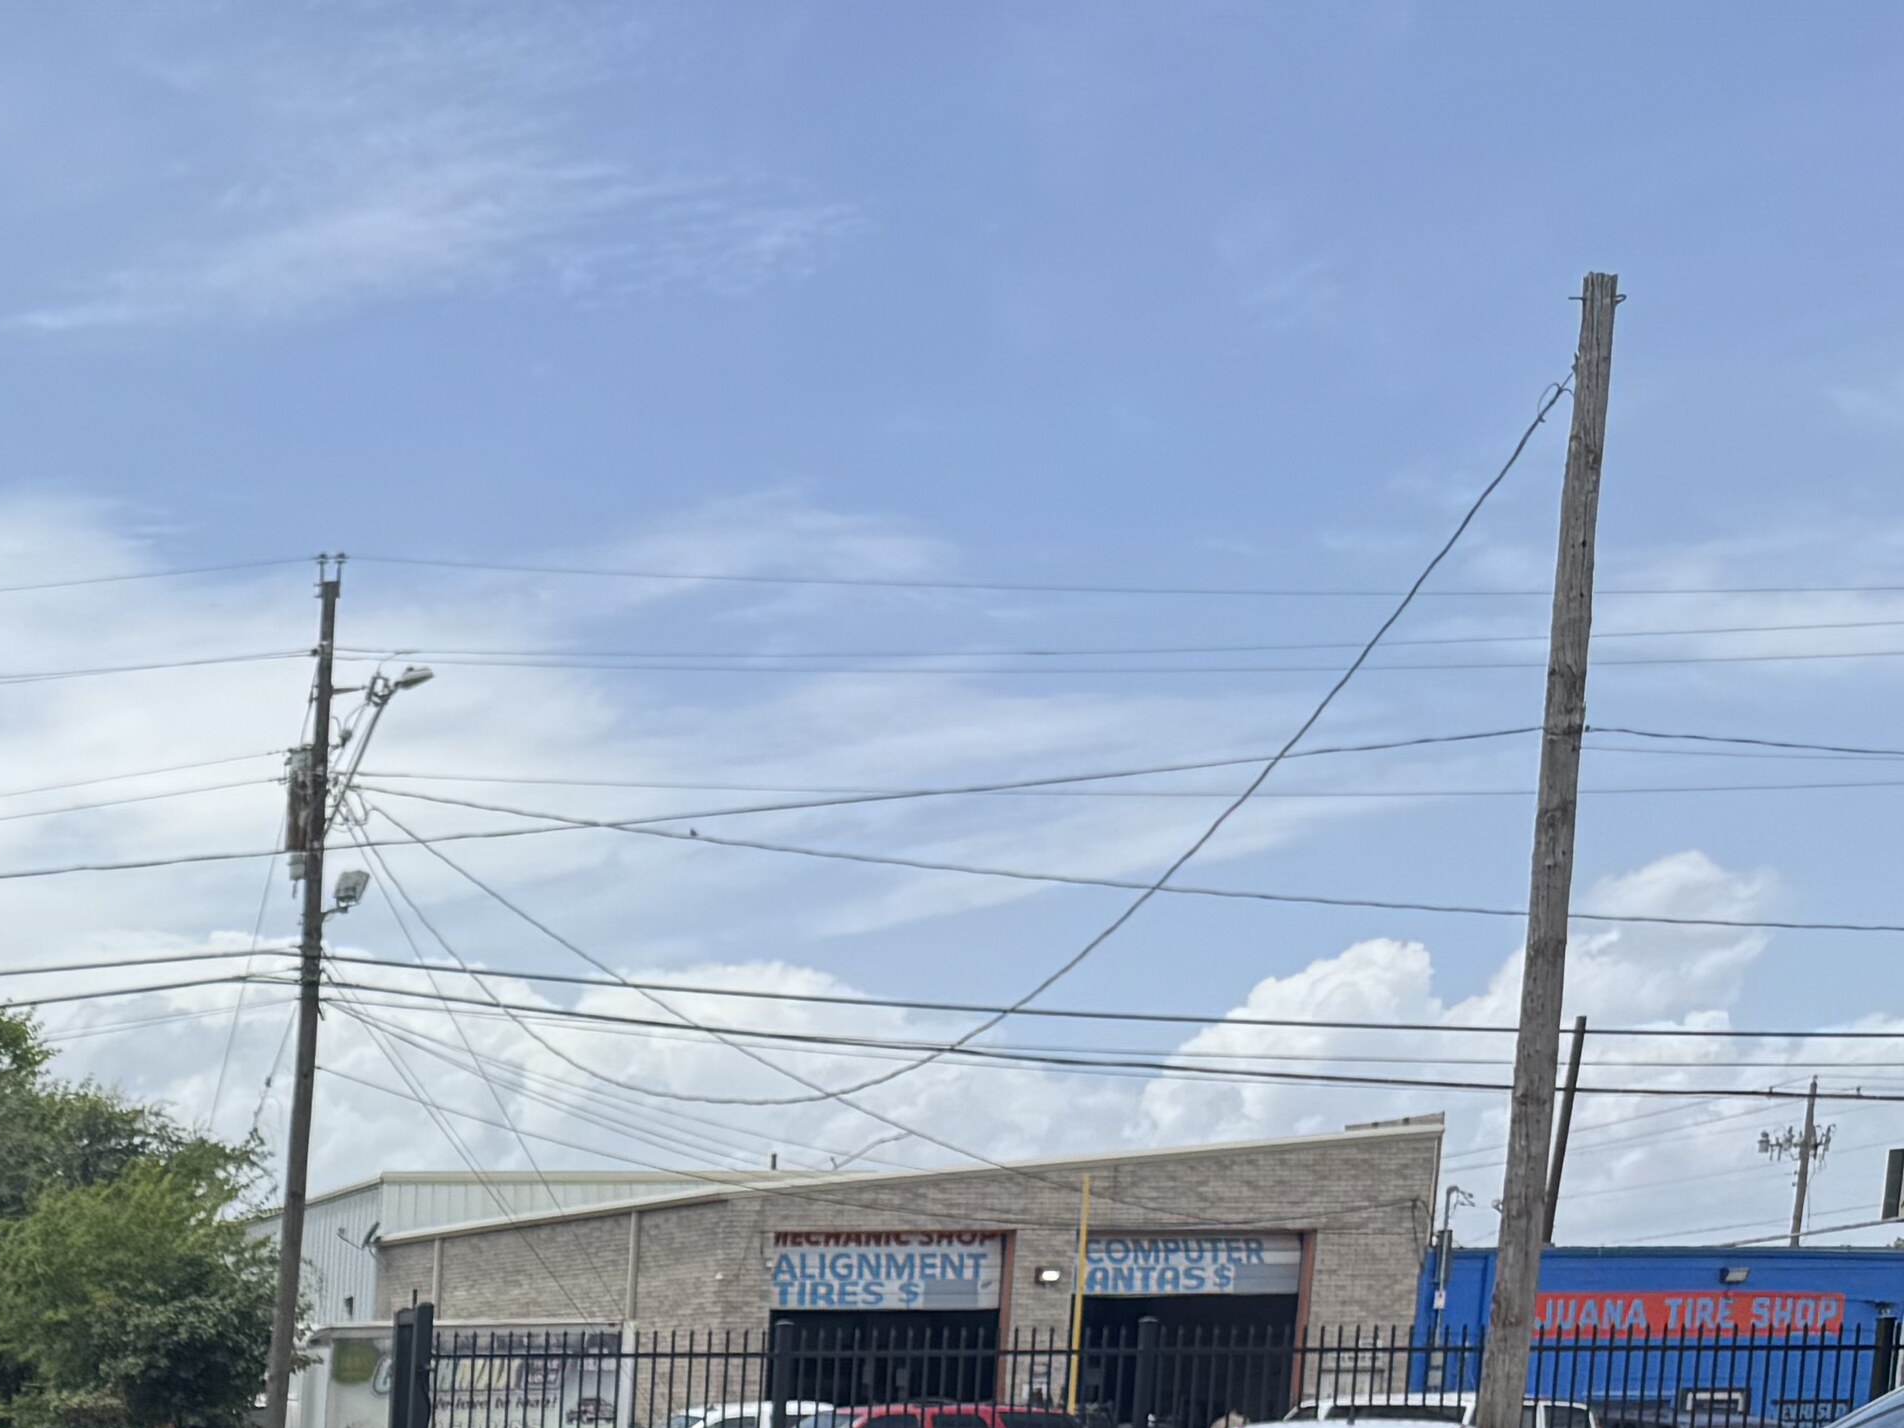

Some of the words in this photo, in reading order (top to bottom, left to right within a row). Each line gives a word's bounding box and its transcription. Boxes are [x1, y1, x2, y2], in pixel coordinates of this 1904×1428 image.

[1085, 1237, 1265, 1265] COMPUTER
[772, 1252, 989, 1282] ALIGNMENT
[1213, 1264, 1233, 1291] $
[772, 1280, 886, 1308] TIRES
[898, 1281, 921, 1311] $
[1664, 1296, 1736, 1331] TIRE
[1750, 1296, 1838, 1332] SHOP
